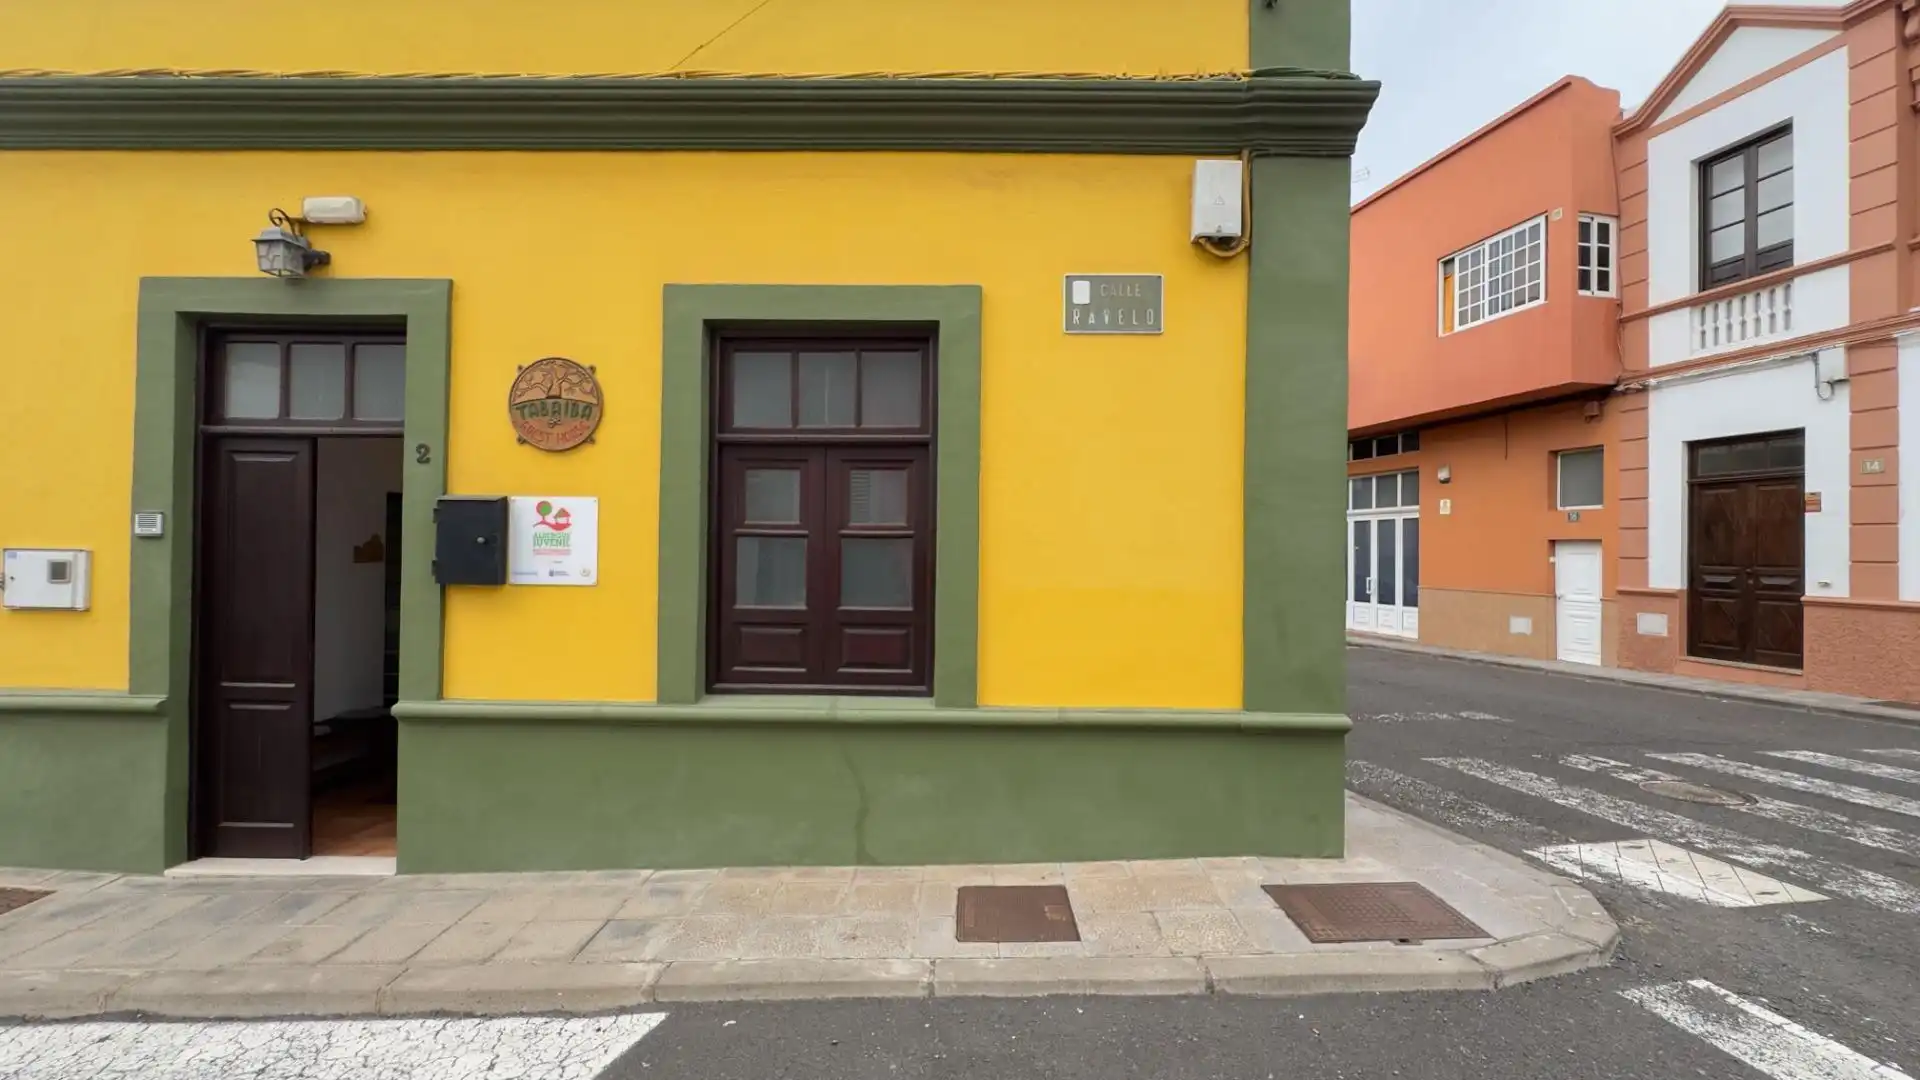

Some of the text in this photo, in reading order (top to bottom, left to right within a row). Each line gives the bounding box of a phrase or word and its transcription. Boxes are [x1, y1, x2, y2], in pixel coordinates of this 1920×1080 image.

[1101, 283, 1141, 297] CALLE
[1073, 308, 1154, 325] RAVELO
[416, 443, 431, 465] 2
[1865, 461, 1880, 472] 14
[533, 539, 570, 548] JUVENIL
